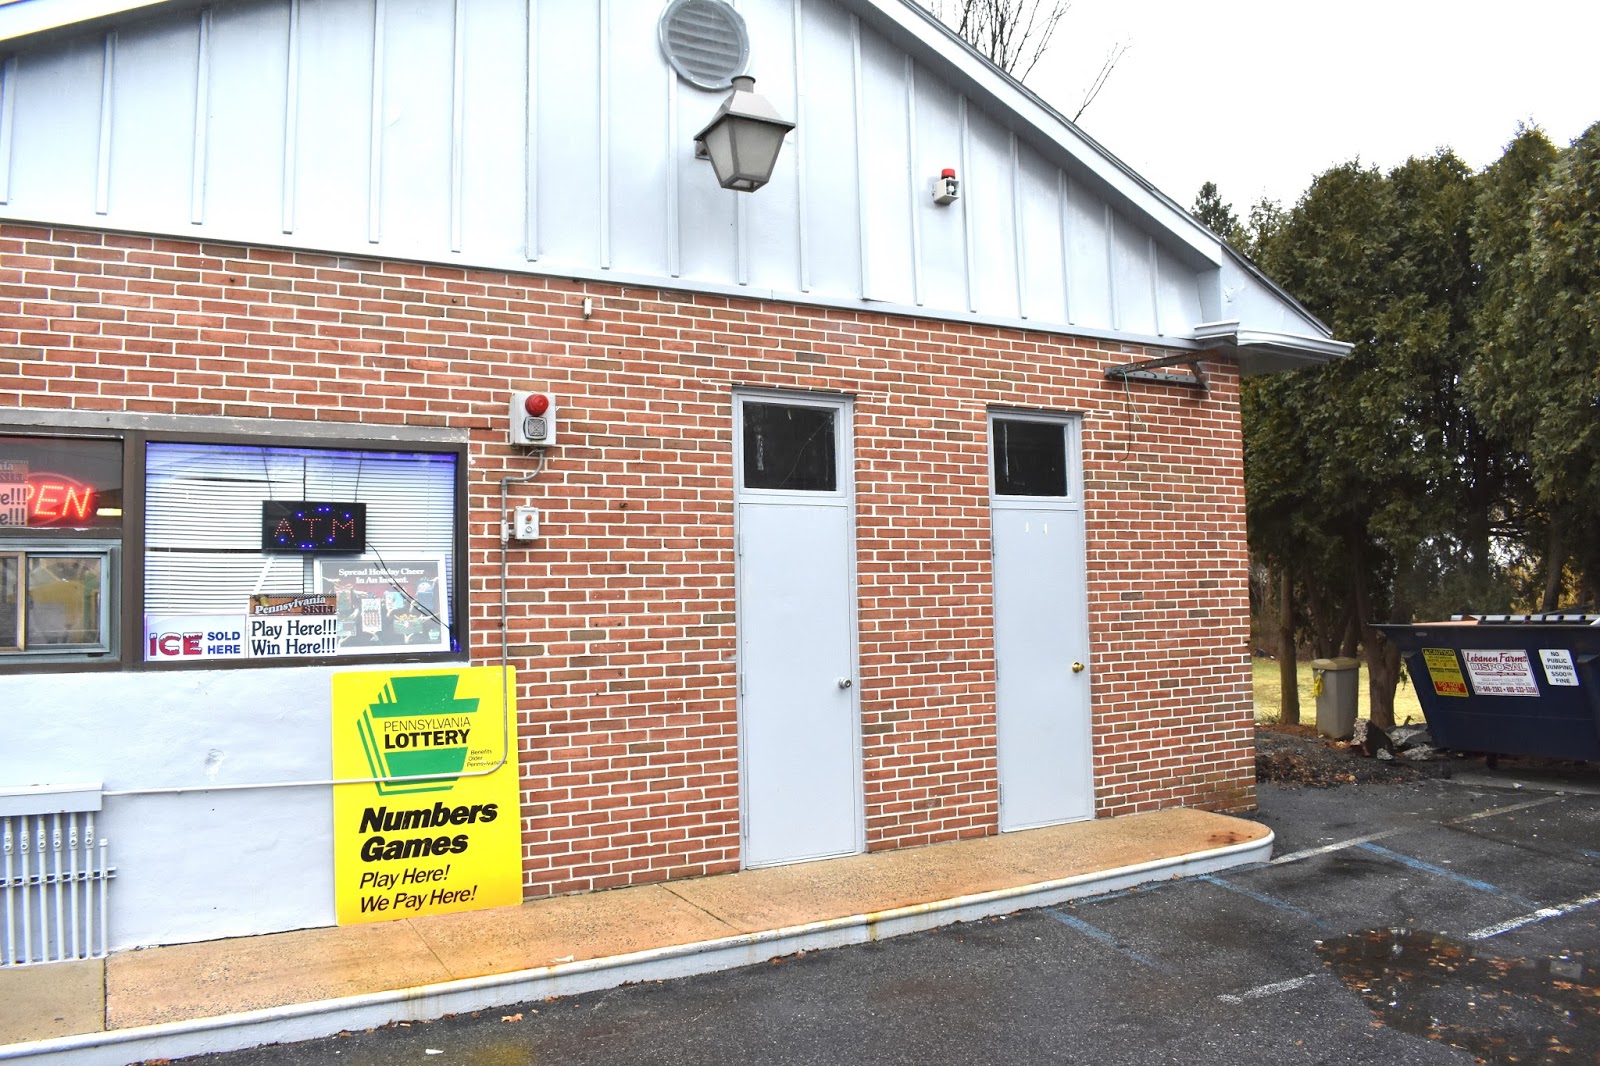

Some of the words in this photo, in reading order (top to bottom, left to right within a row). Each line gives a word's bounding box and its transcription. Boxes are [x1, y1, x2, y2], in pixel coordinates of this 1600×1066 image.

[274, 518, 354, 538] ATM
[338, 568, 367, 577] Spread
[369, 568, 400, 577] Holiday
[400, 567, 425, 575] Cheer
[254, 595, 326, 614] Pennsylvania
[207, 631, 241, 641] SOLD
[251, 620, 282, 640] Play
[287, 619, 337, 635] Here!!!
[150, 632, 203, 656] ICE
[207, 644, 241, 655] HERE
[251, 639, 281, 656] Win
[286, 637, 336, 654] Here!!!
[1466, 652, 1498, 662] Lebanon
[1470, 663, 1528, 671] DISPOSAL
[384, 717, 471, 732] PENNSYLVANIA
[384, 729, 471, 749] LOTTERY
[358, 802, 498, 833] Numbers
[360, 834, 469, 862] Games
[359, 871, 400, 890] Play
[402, 864, 450, 885] Here!
[361, 894, 389, 913] We
[393, 892, 427, 911] Pay
[429, 885, 477, 906] Here!
